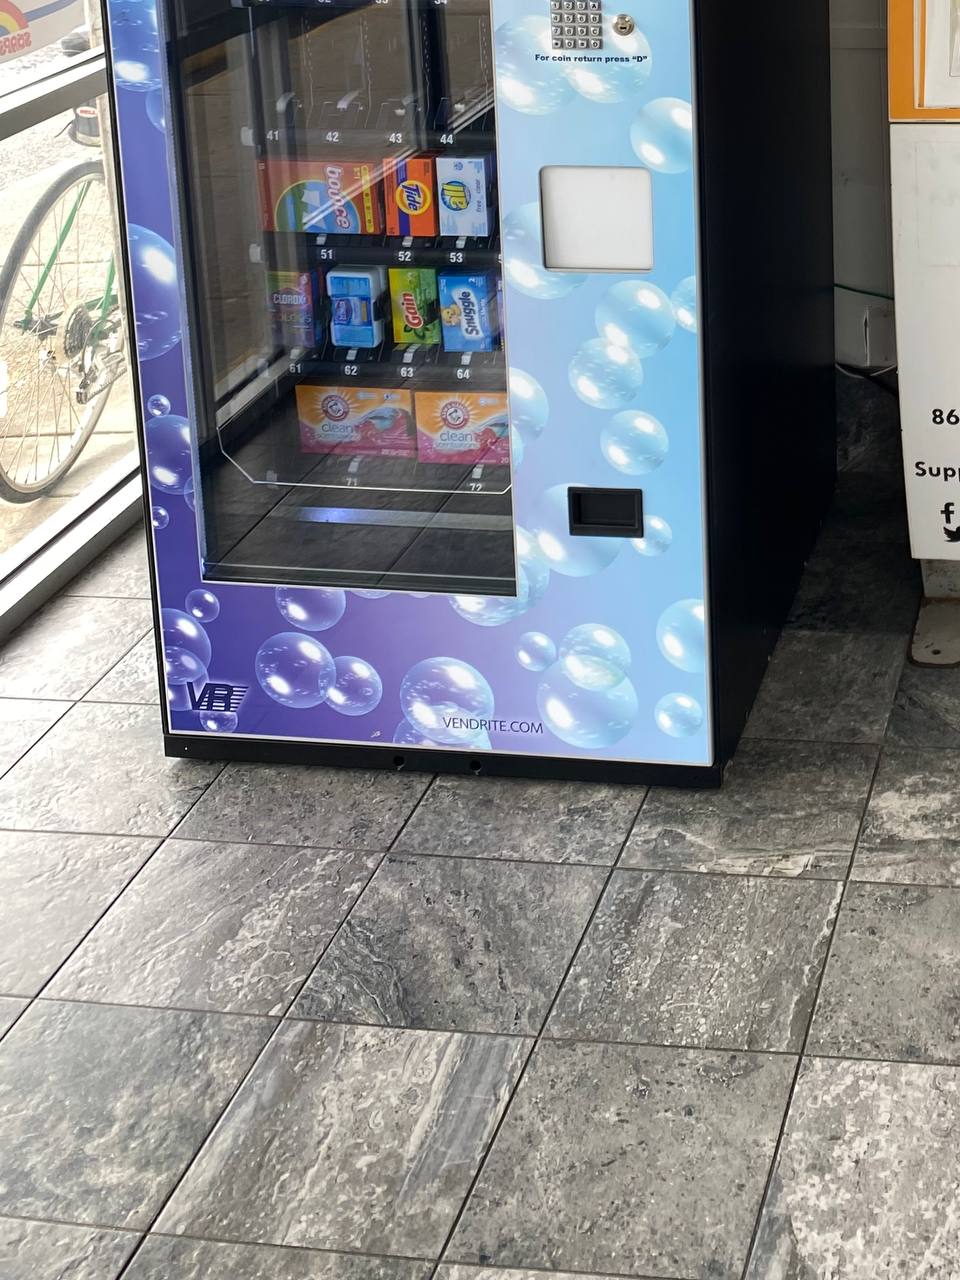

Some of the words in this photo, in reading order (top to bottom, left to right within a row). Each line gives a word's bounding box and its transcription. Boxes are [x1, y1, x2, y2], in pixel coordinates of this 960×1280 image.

[552, 54, 571, 62] coin
[605, 56, 630, 64] press
[326, 131, 339, 143] 42
[401, 184, 425, 212] Tide
[320, 249, 333, 260] 51
[398, 250, 412, 262] 52
[449, 252, 463, 263] 53
[402, 293, 424, 328] Gain
[461, 290, 479, 336] Snuggle
[344, 365, 358, 376] 62
[400, 367, 414, 378] 63
[457, 369, 471, 380] 64
[321, 423, 353, 434] clean
[442, 716, 544, 734] VENDRITE.COM
